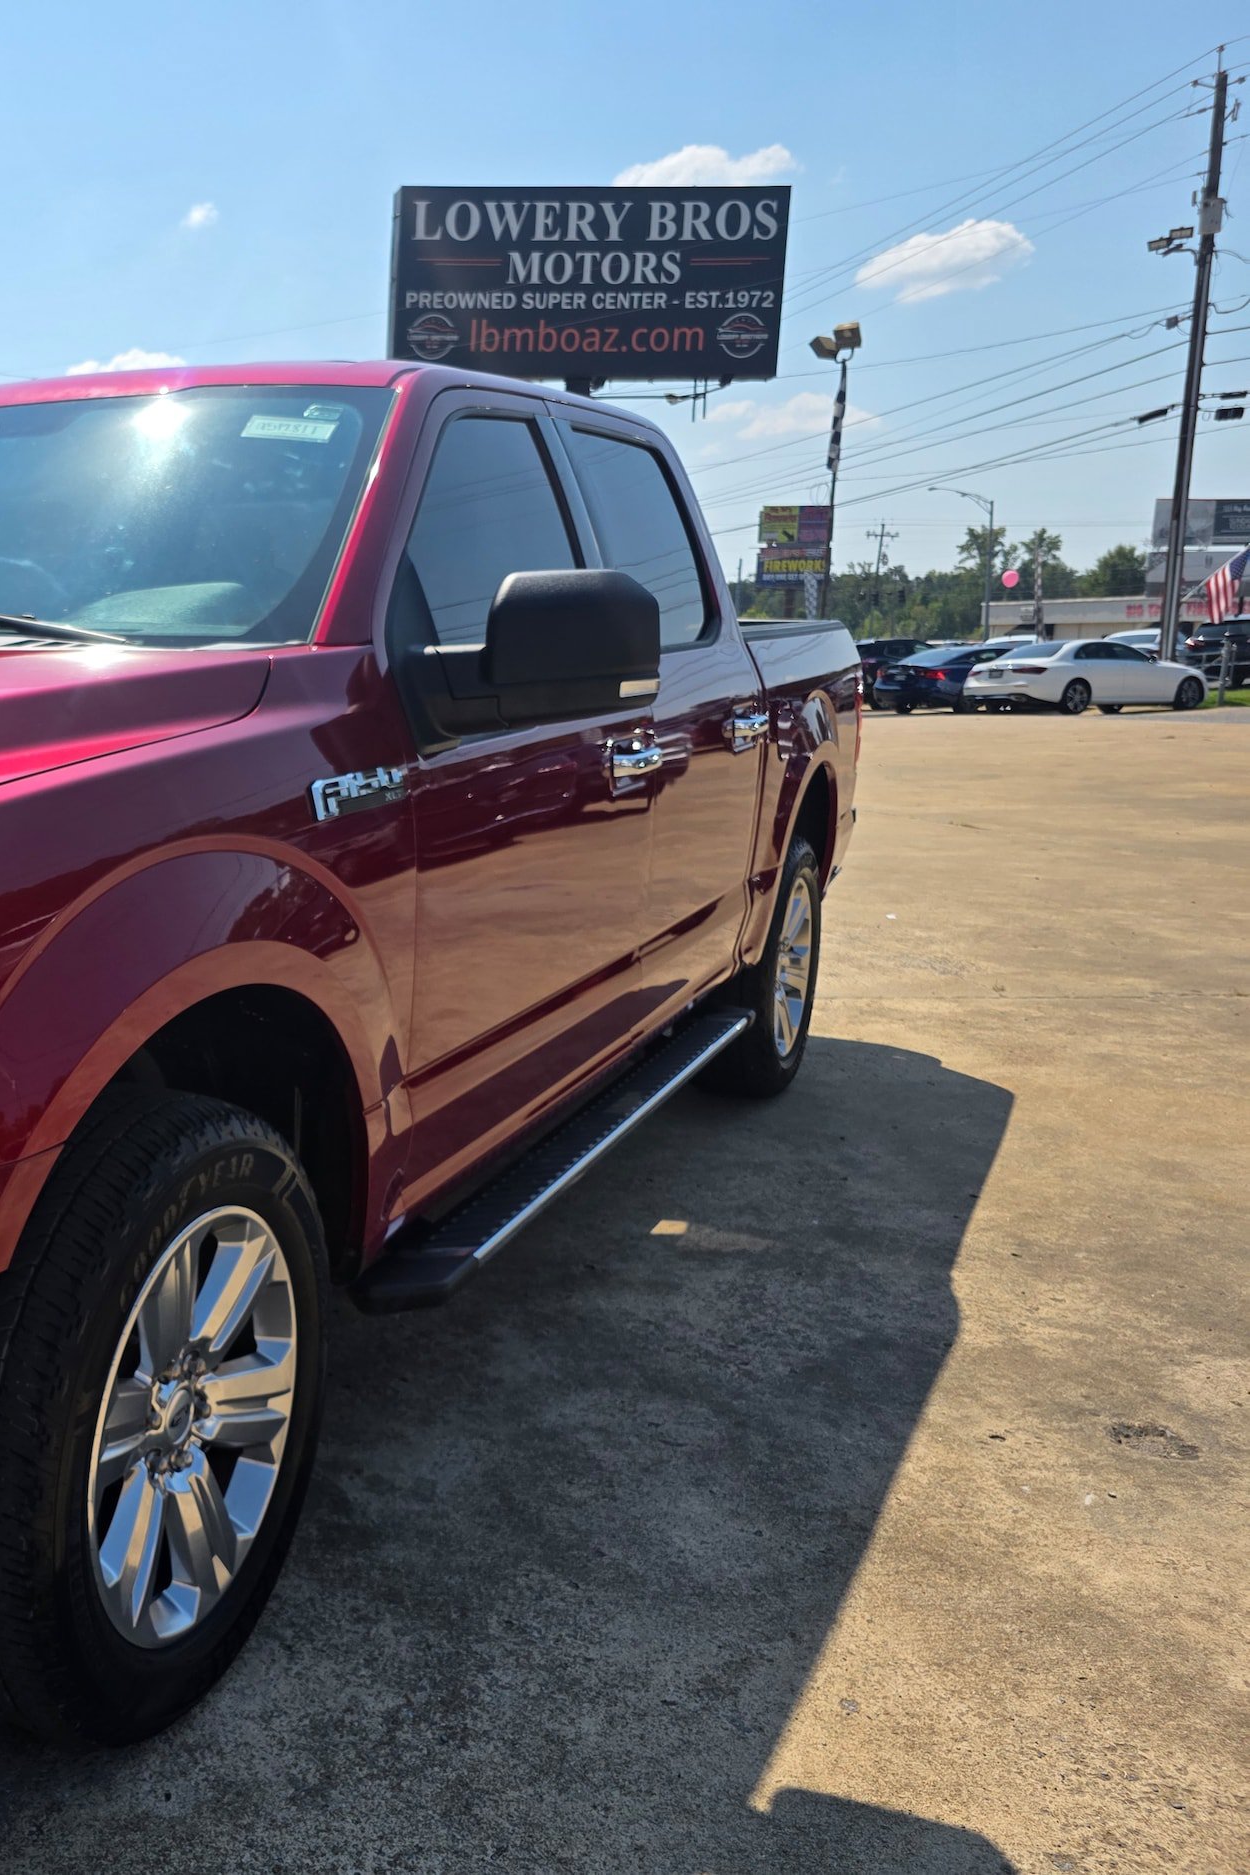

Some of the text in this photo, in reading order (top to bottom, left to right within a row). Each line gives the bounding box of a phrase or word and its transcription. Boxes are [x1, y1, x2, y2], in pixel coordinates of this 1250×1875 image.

[411, 199, 779, 242] LOWERY BROS
[505, 250, 682, 285] MOTORS
[405, 290, 518, 310] PREOWNED
[522, 291, 587, 310] SUPER
[591, 291, 668, 310] CENTER
[684, 290, 775, 310] EST.1972
[468, 318, 705, 353] lbmboaz.com
